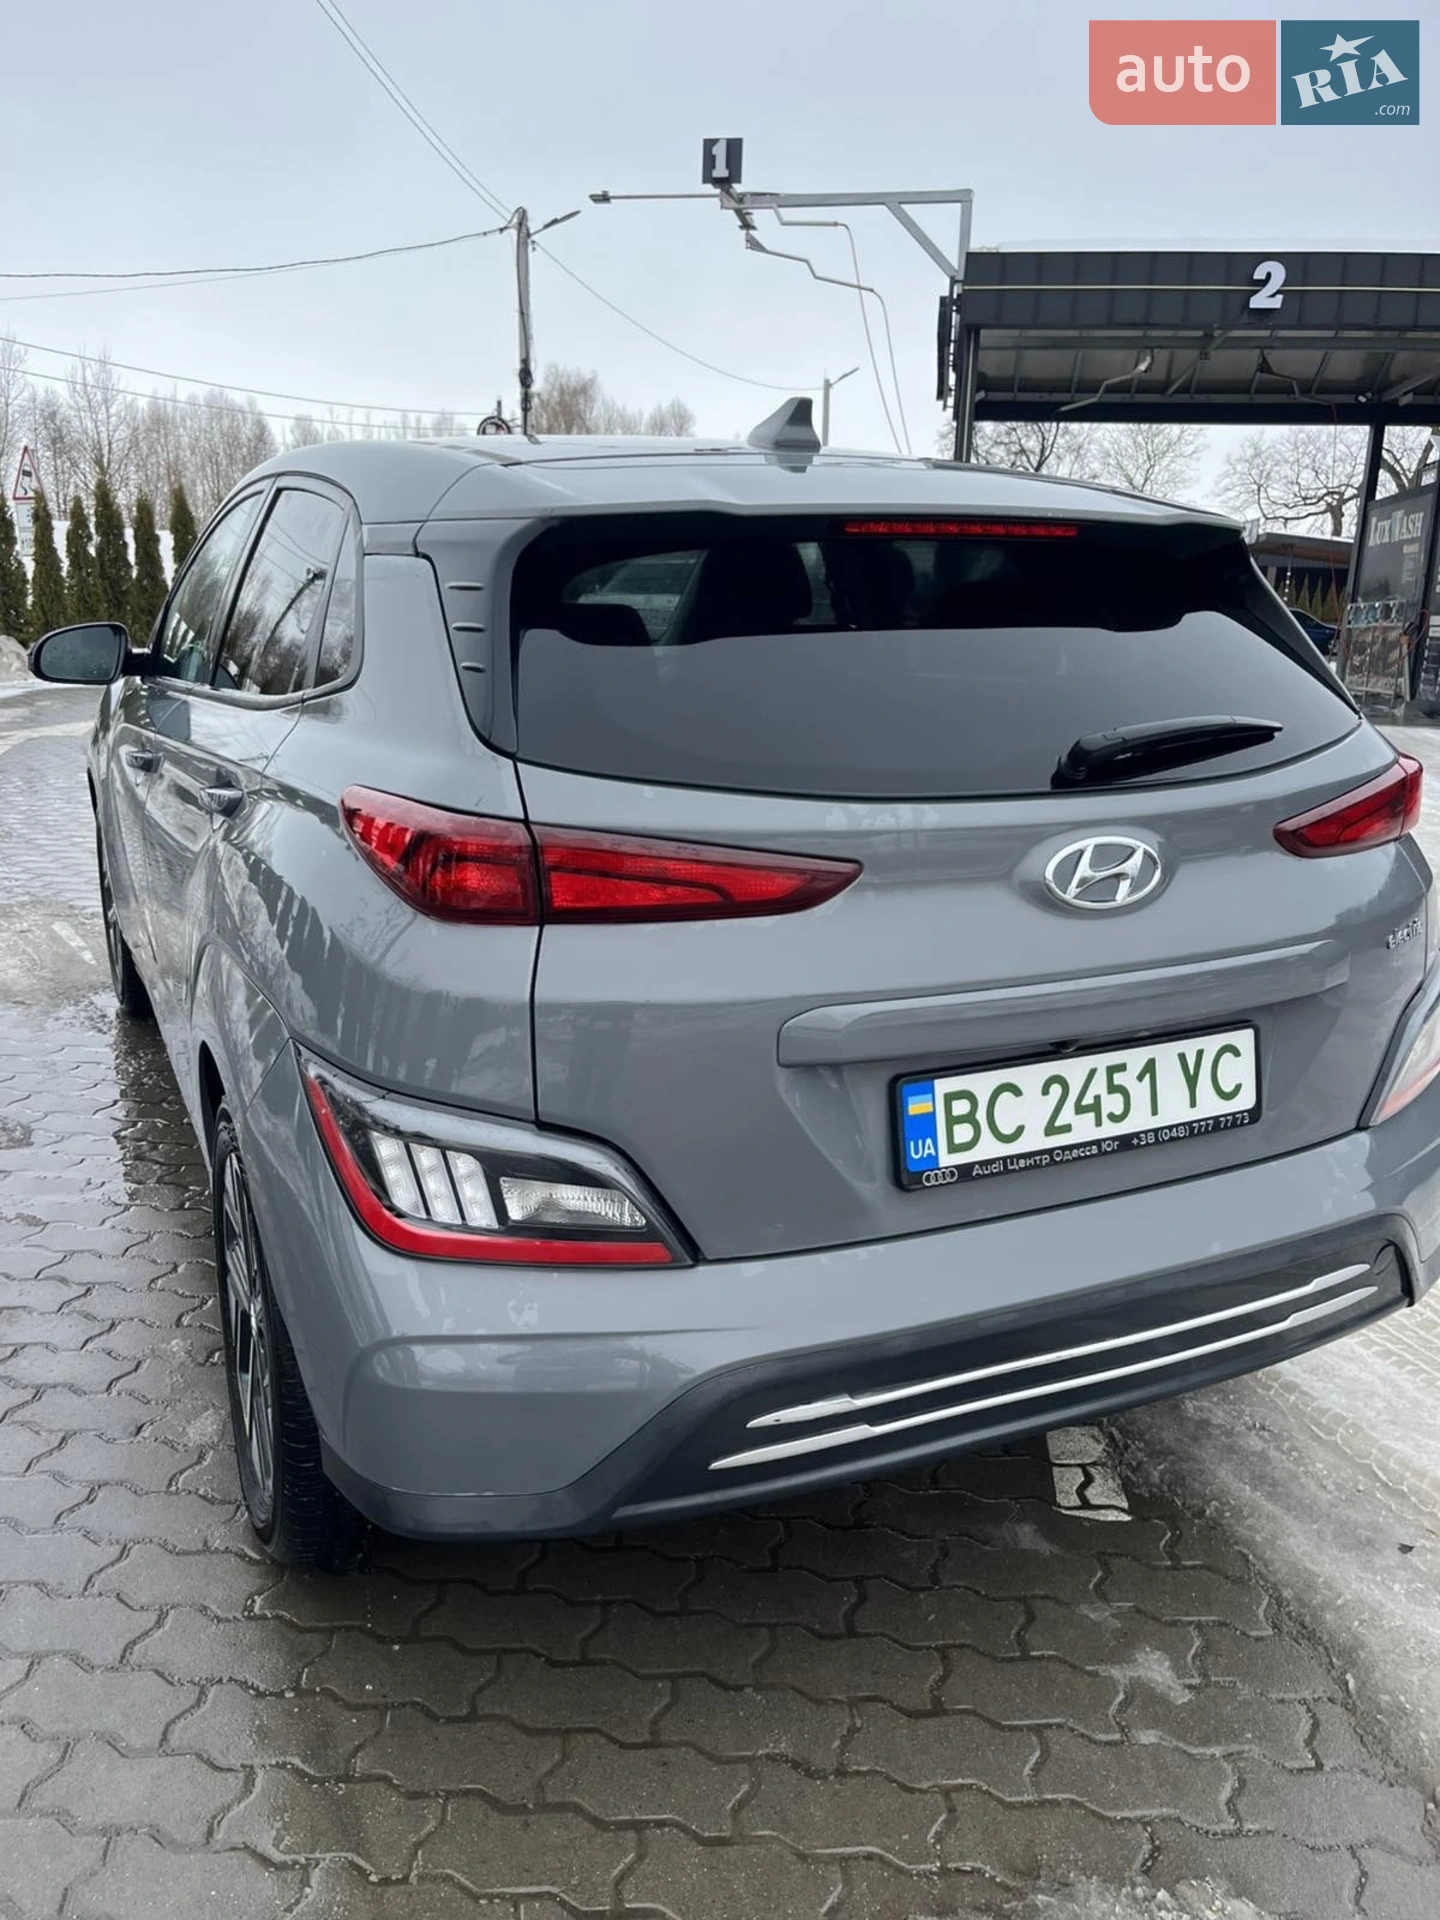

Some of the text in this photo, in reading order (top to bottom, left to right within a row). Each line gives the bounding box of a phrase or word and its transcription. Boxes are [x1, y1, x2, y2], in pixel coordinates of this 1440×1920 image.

[711, 138, 730, 178] 1
[1249, 260, 1286, 309] 2
[943, 1043, 1243, 1155] BC 2451 YC
[909, 1138, 936, 1160] UA
[972, 1160, 1004, 1177] Audi
[1007, 1153, 1050, 1170] Центр
[1053, 1144, 1098, 1161] Одесса
[1101, 1140, 1119, 1153] Юг
[1132, 1132, 1155, 1146] +38
[1158, 1125, 1189, 1142] (048)
[1192, 1119, 1214, 1134] 777
